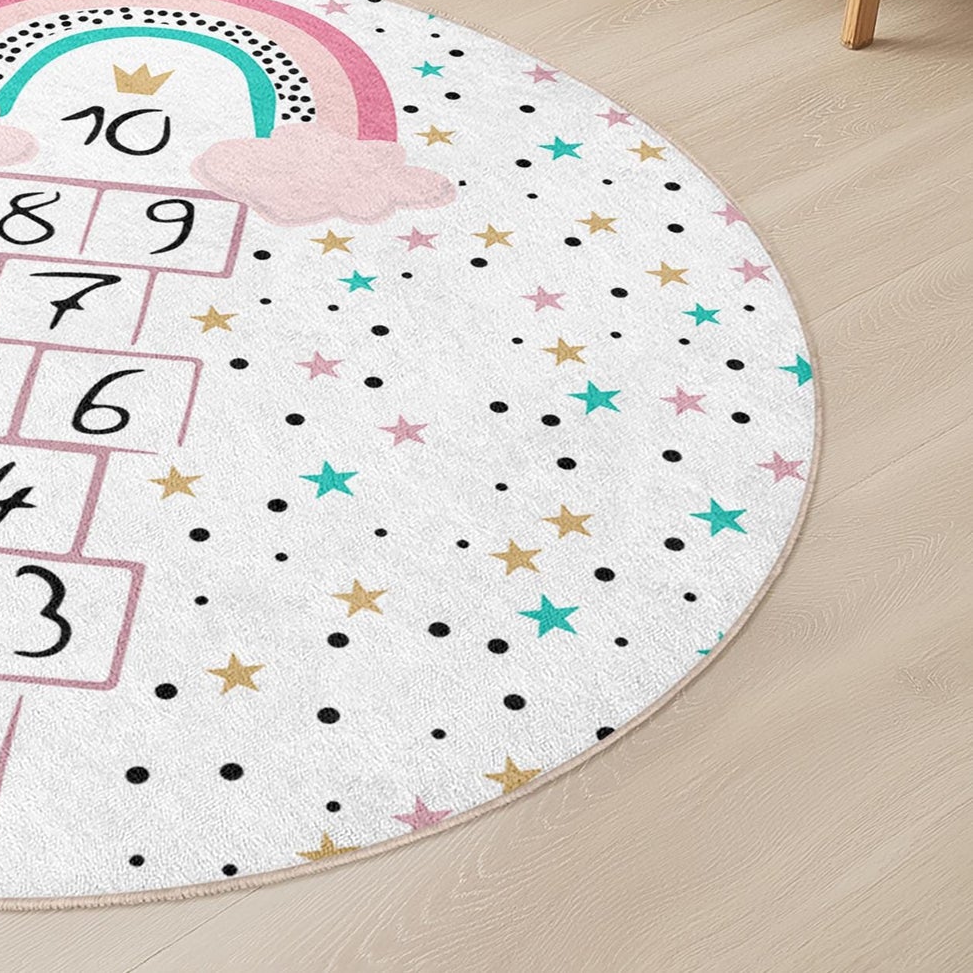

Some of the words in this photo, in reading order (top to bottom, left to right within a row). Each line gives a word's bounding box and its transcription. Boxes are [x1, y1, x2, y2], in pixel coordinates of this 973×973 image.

[61, 105, 171, 156] 10
[146, 198, 195, 255] 9
[30, 271, 122, 330] 7
[71, 369, 145, 435] 6
[14, 564, 72, 658] 3
